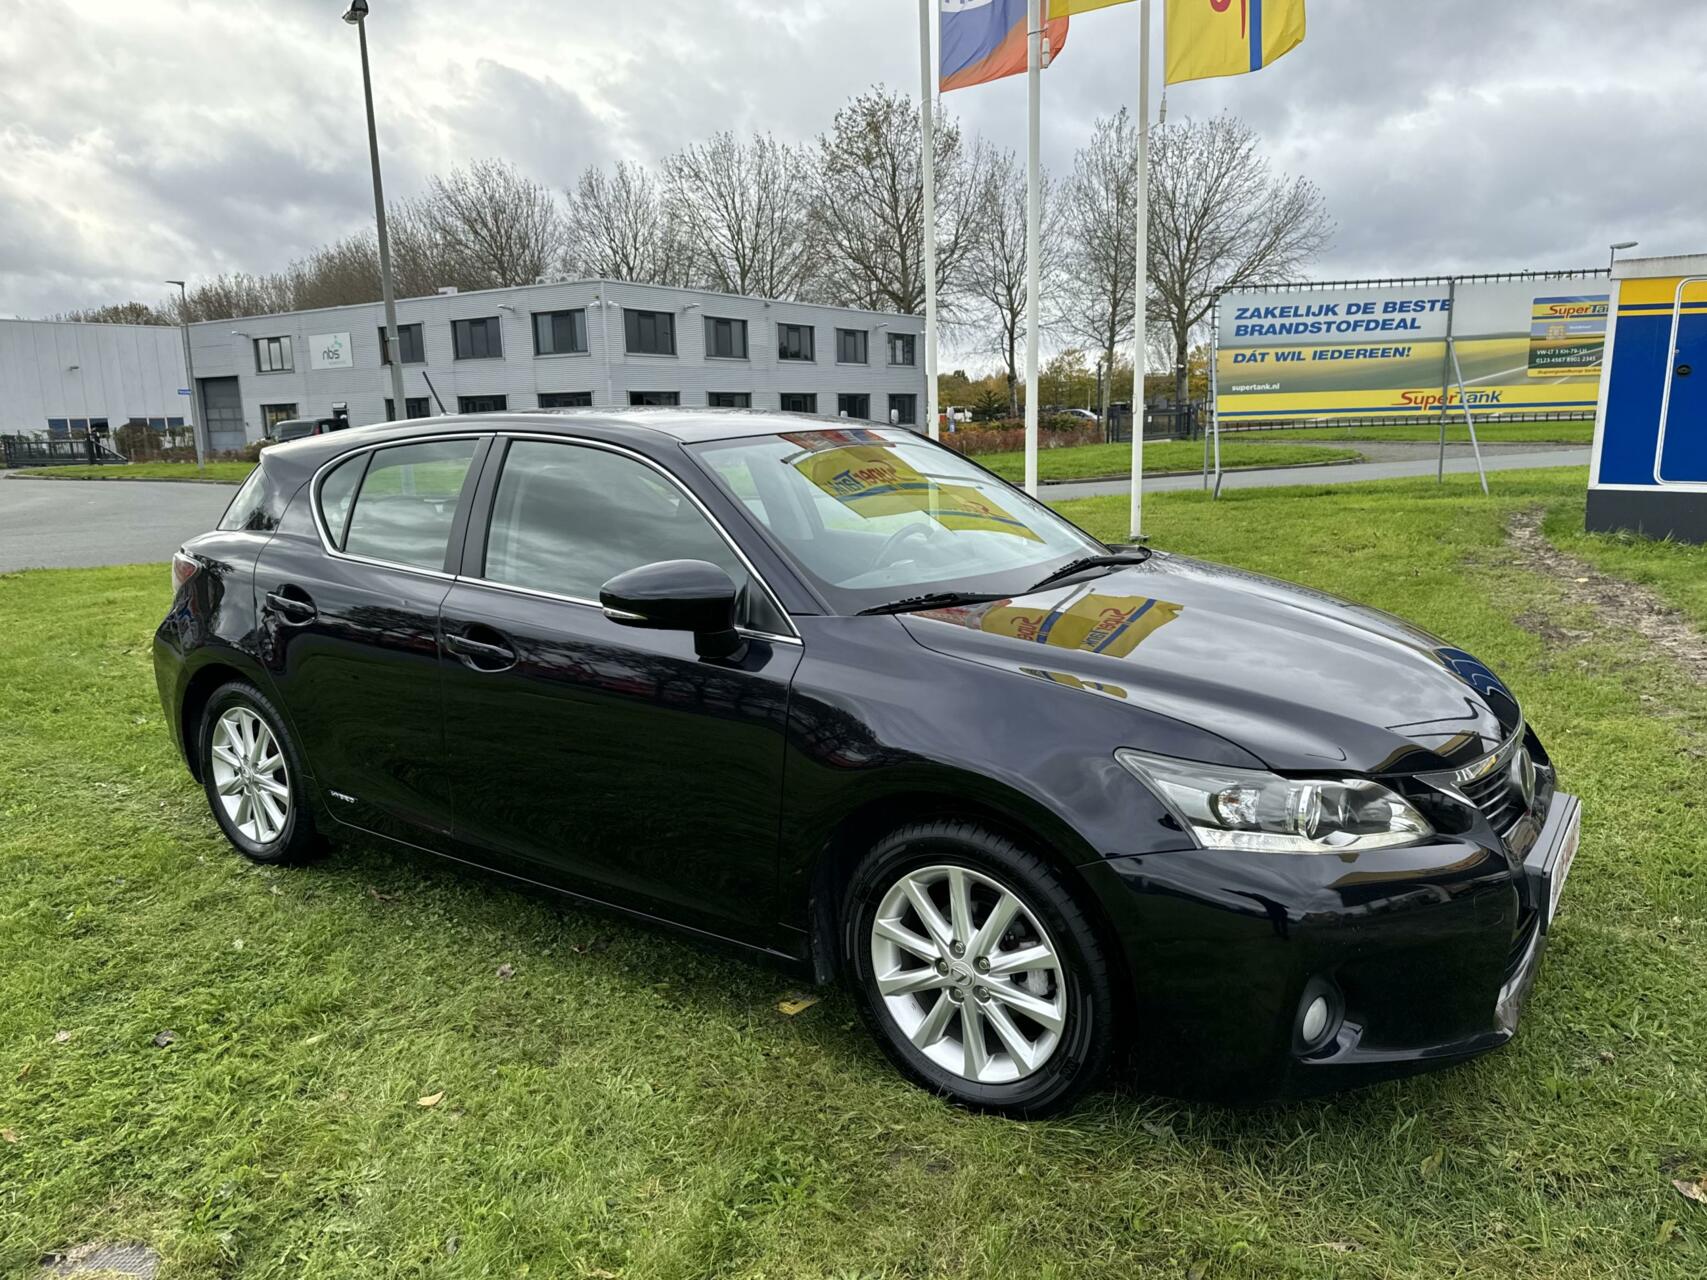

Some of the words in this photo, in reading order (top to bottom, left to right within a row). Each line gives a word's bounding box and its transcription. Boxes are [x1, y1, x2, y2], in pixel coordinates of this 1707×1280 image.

[1234, 303, 1340, 320] ZAKELIJK
[1345, 302, 1376, 315] DE
[1382, 298, 1453, 314] BESTE
[1234, 318, 1421, 336] BRANDSTOFDEAL
[1233, 349, 1270, 363] DÁT
[1274, 350, 1306, 362] WIL
[1312, 346, 1412, 361] IEDEREEN!
[1231, 383, 1280, 392] supertank.nl
